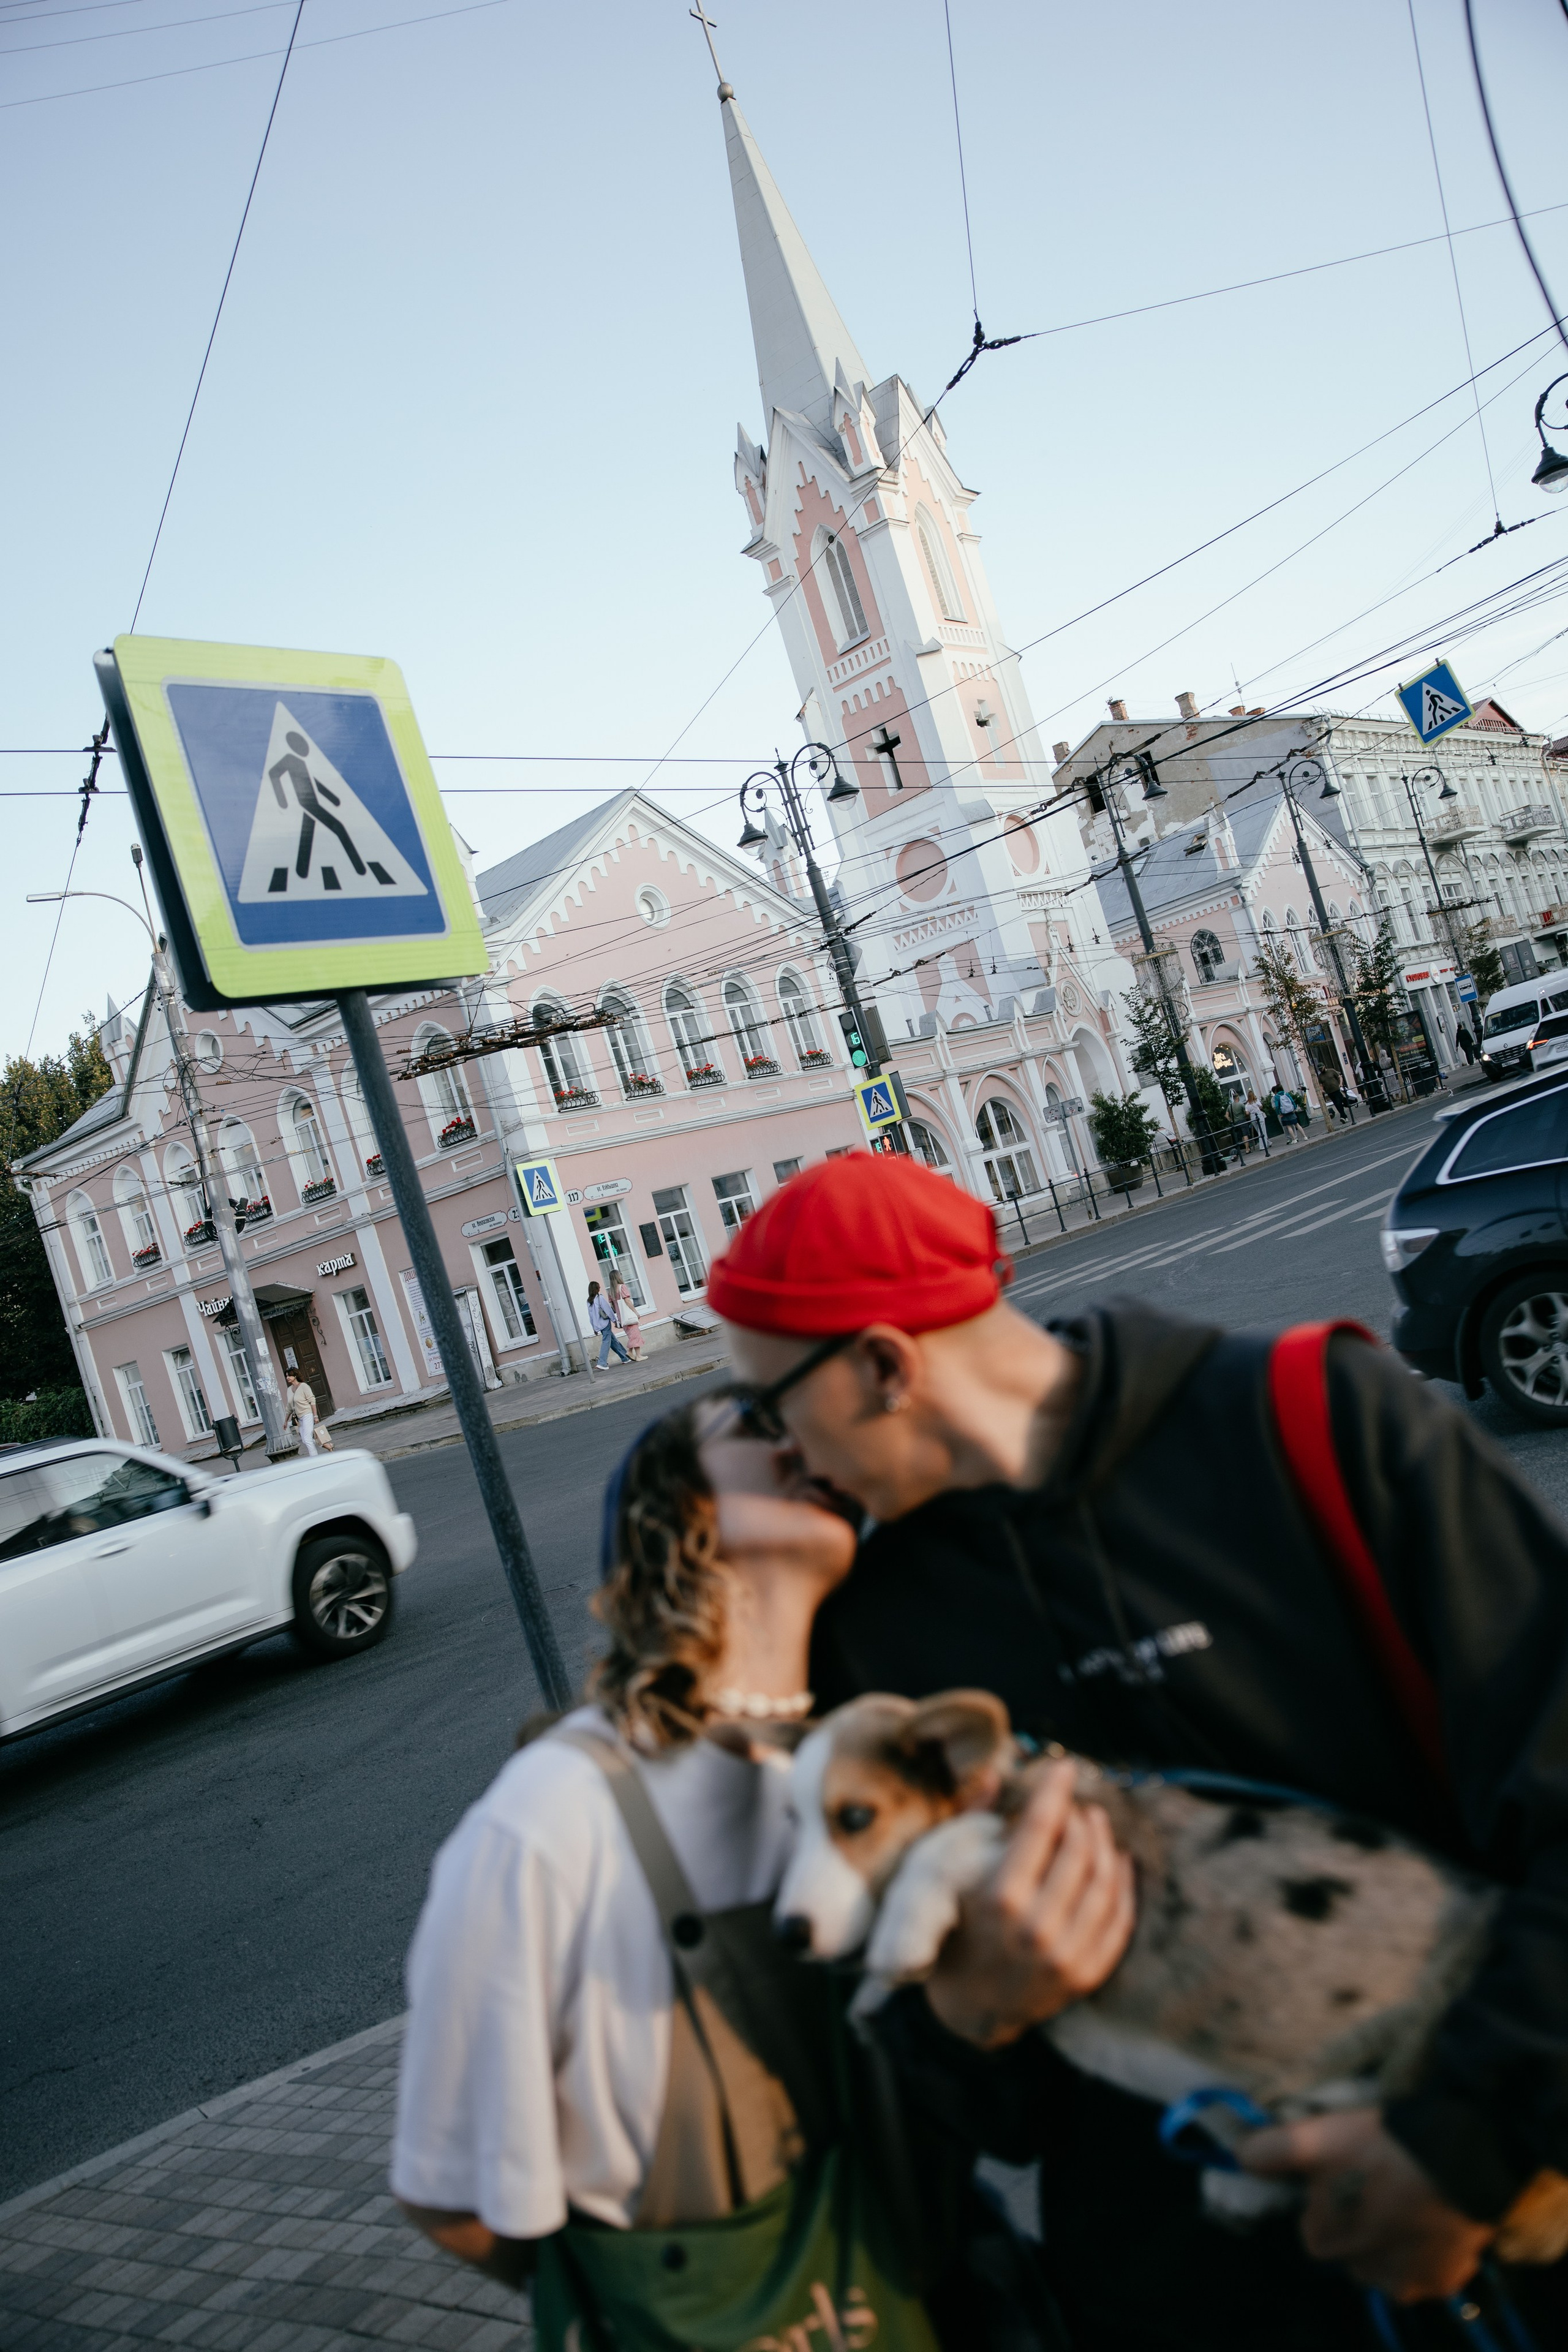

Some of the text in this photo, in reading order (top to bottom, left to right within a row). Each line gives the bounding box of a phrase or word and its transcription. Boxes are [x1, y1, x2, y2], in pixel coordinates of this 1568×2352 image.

[851, 1032, 861, 1045] 16
[568, 1192, 579, 1202] 117
[315, 1253, 355, 1276] карта
